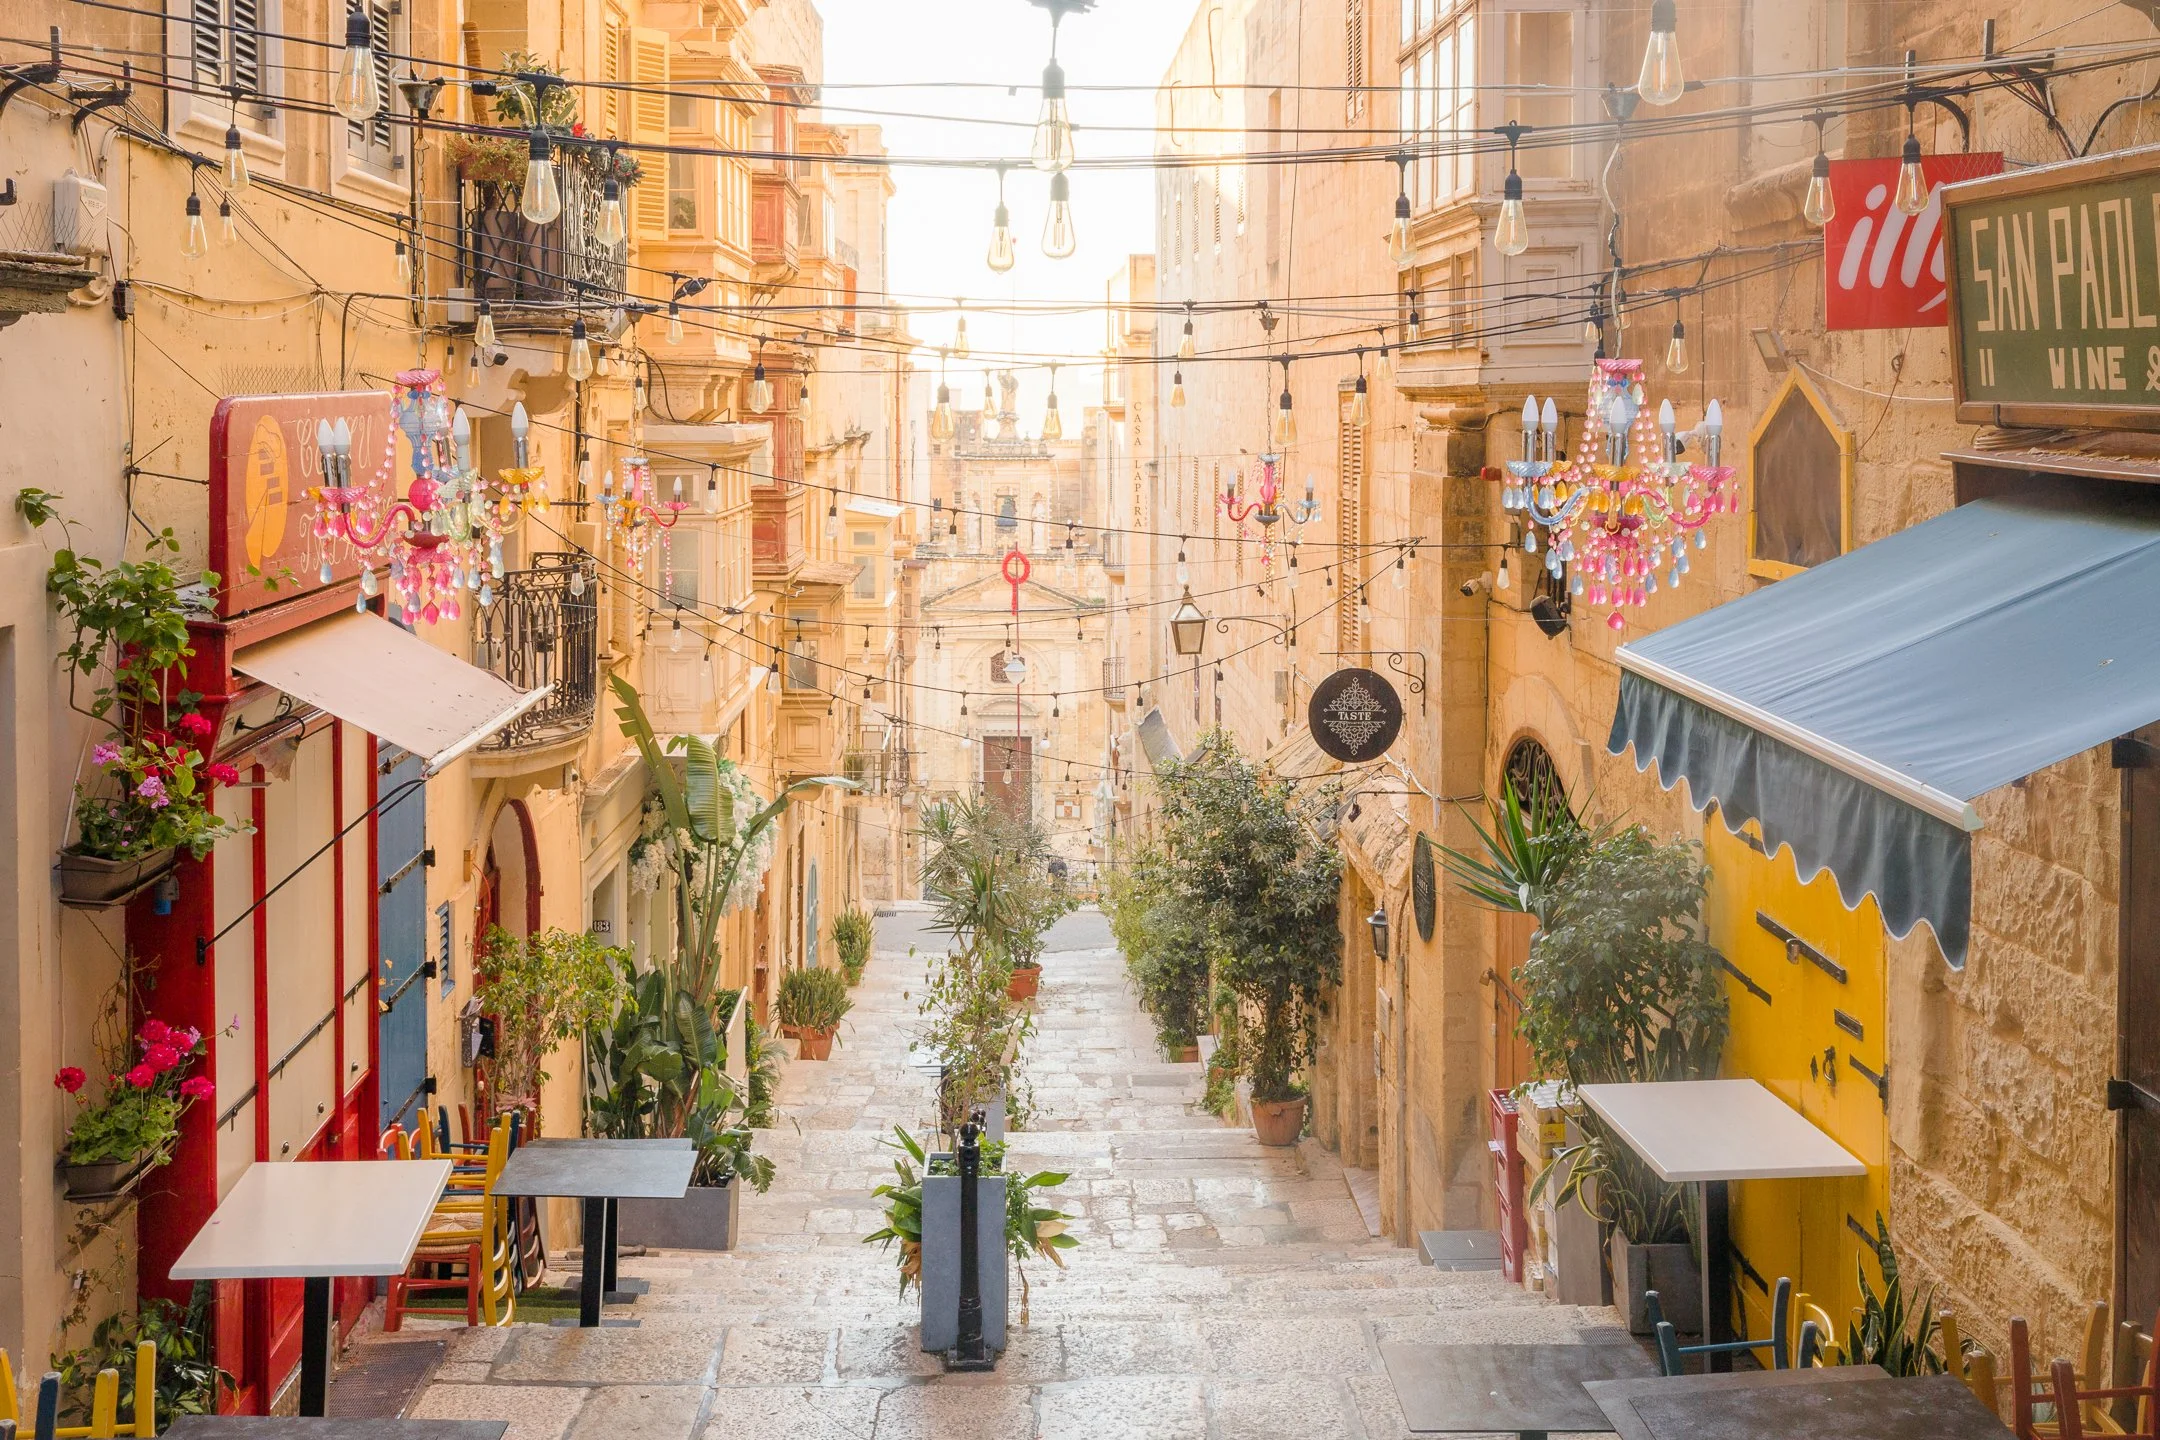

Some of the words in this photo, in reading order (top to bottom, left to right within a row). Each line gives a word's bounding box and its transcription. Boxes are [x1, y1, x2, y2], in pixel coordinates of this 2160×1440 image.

[1970, 211, 2040, 332] SAN
[2048, 346, 2127, 390] WINE
[1133, 402, 1142, 446] CASA
[1338, 712, 1372, 721] TASTE
[593, 921, 610, 932] 183
